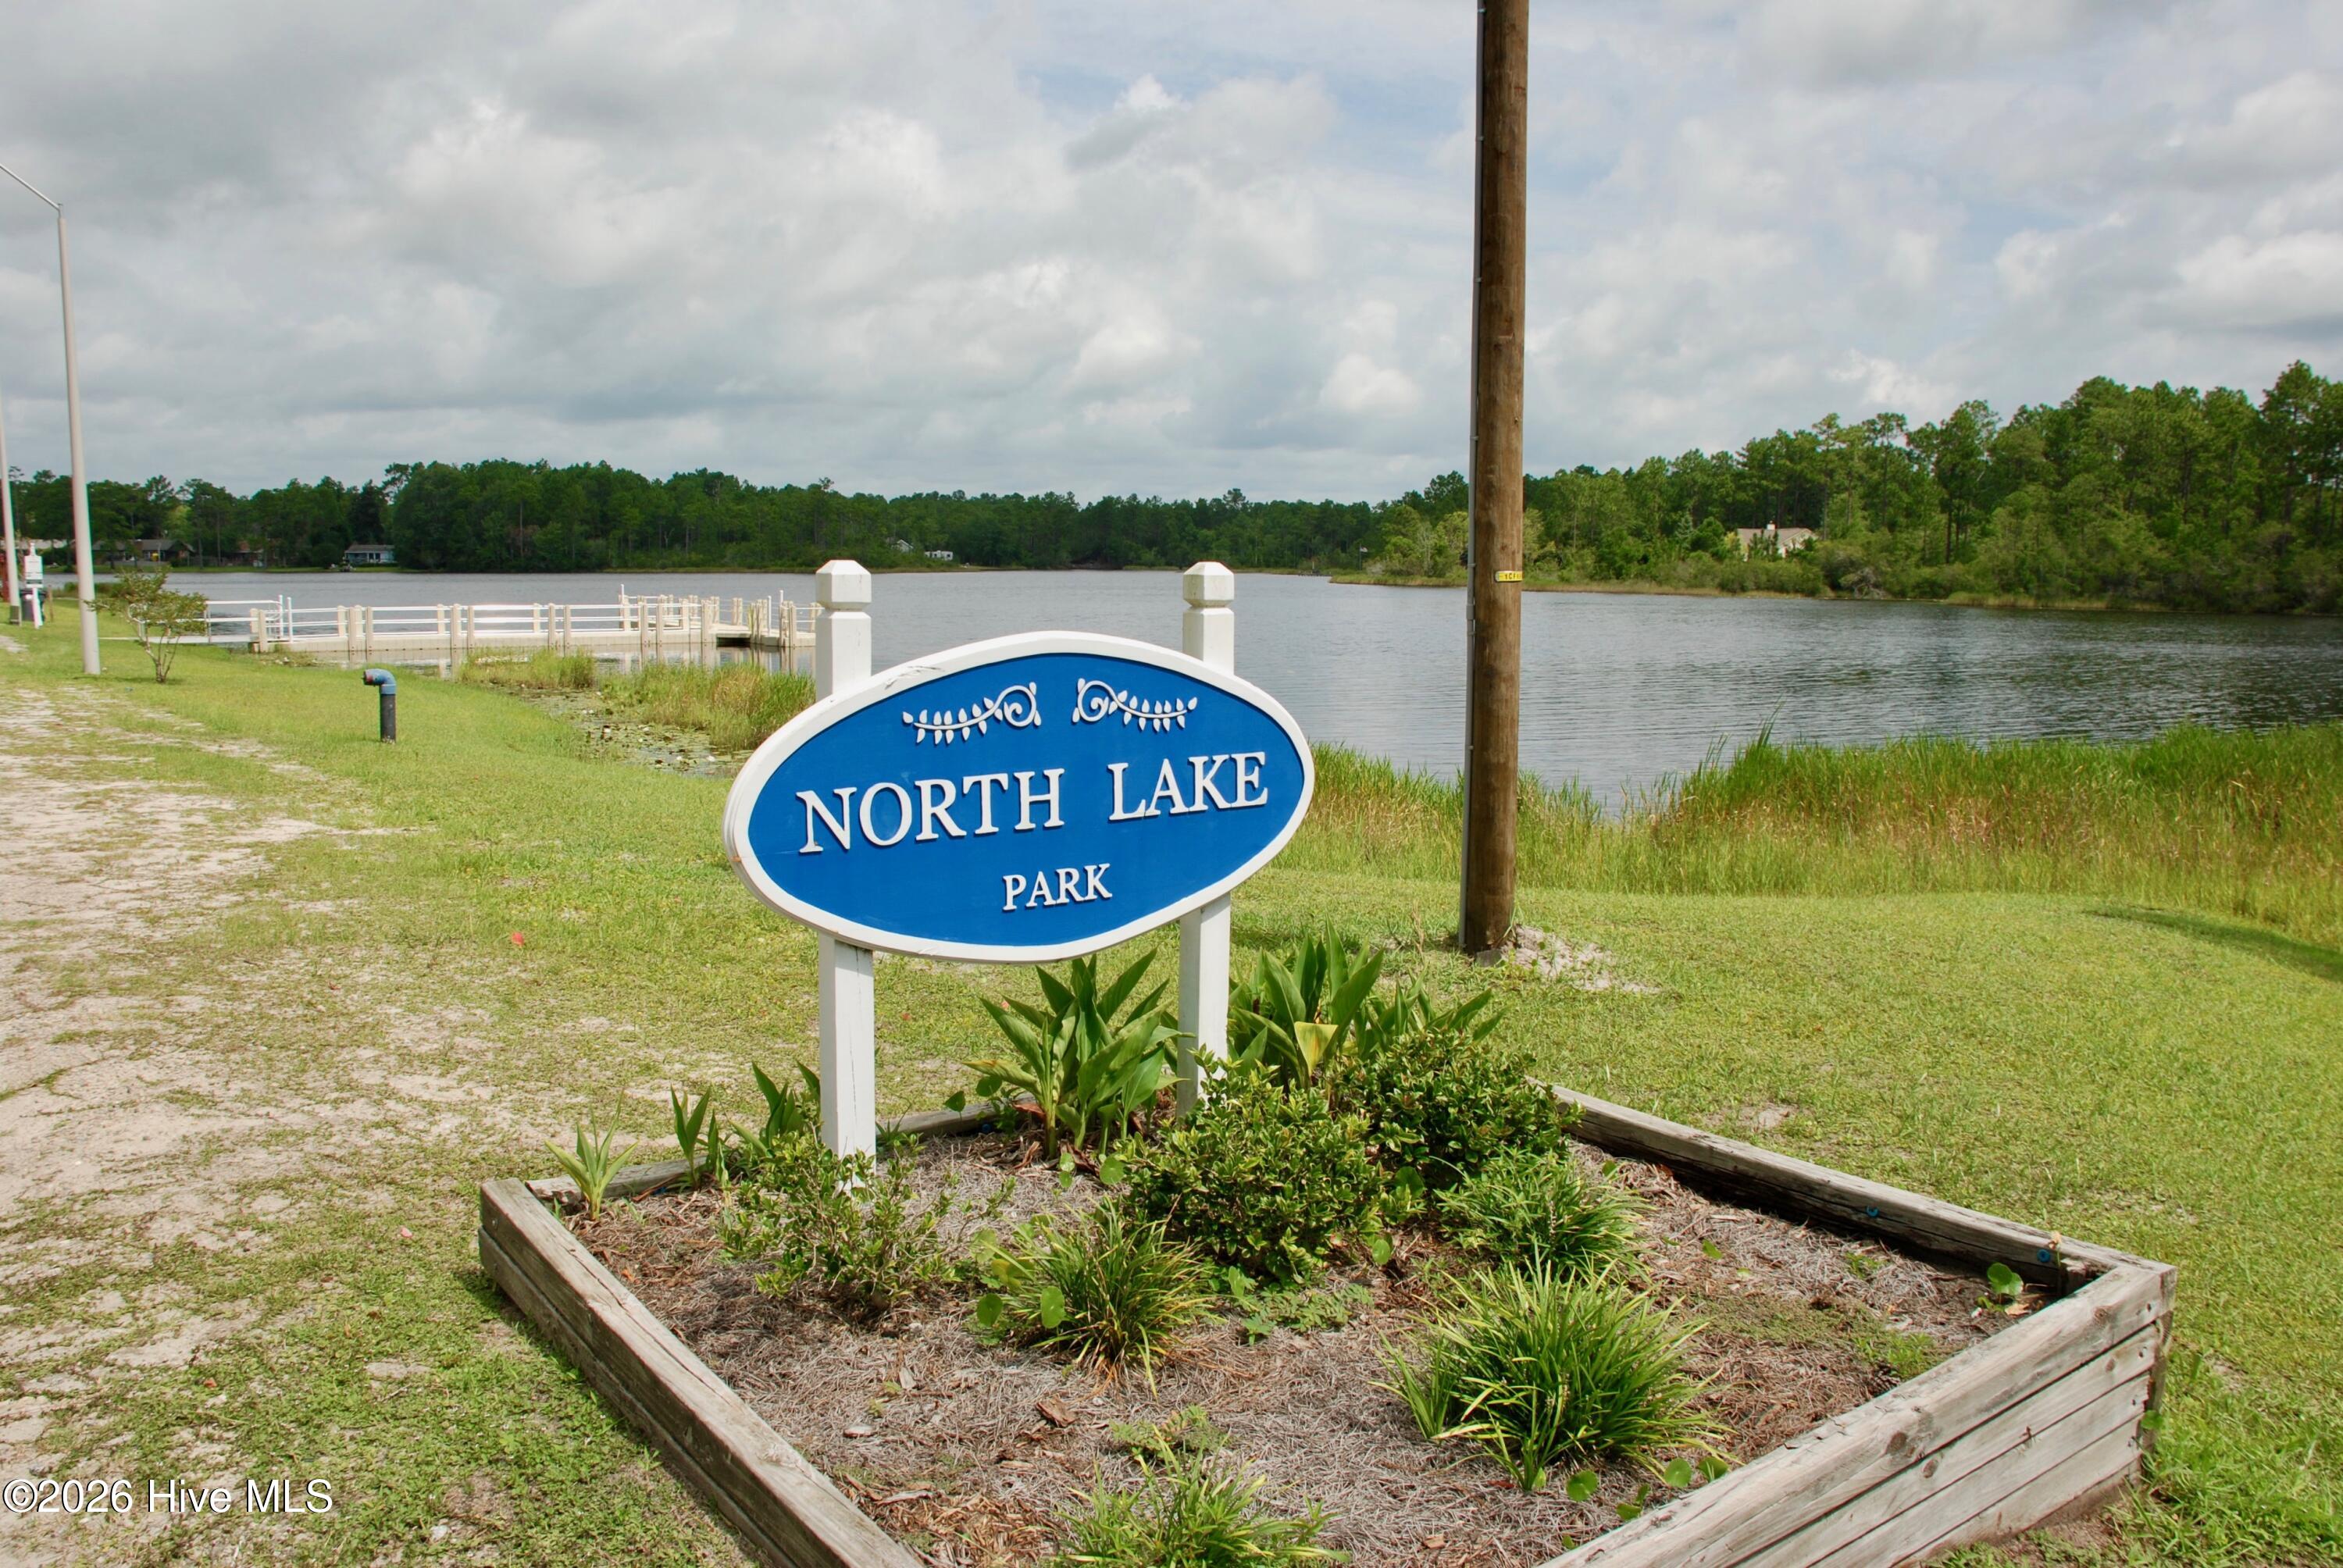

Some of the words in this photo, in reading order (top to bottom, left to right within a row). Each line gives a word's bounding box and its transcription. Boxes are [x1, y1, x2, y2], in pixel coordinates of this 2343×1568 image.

[796, 768, 1065, 853] NORTH
[1107, 751, 1268, 821] LAKE
[1002, 863, 1112, 911] PARK
